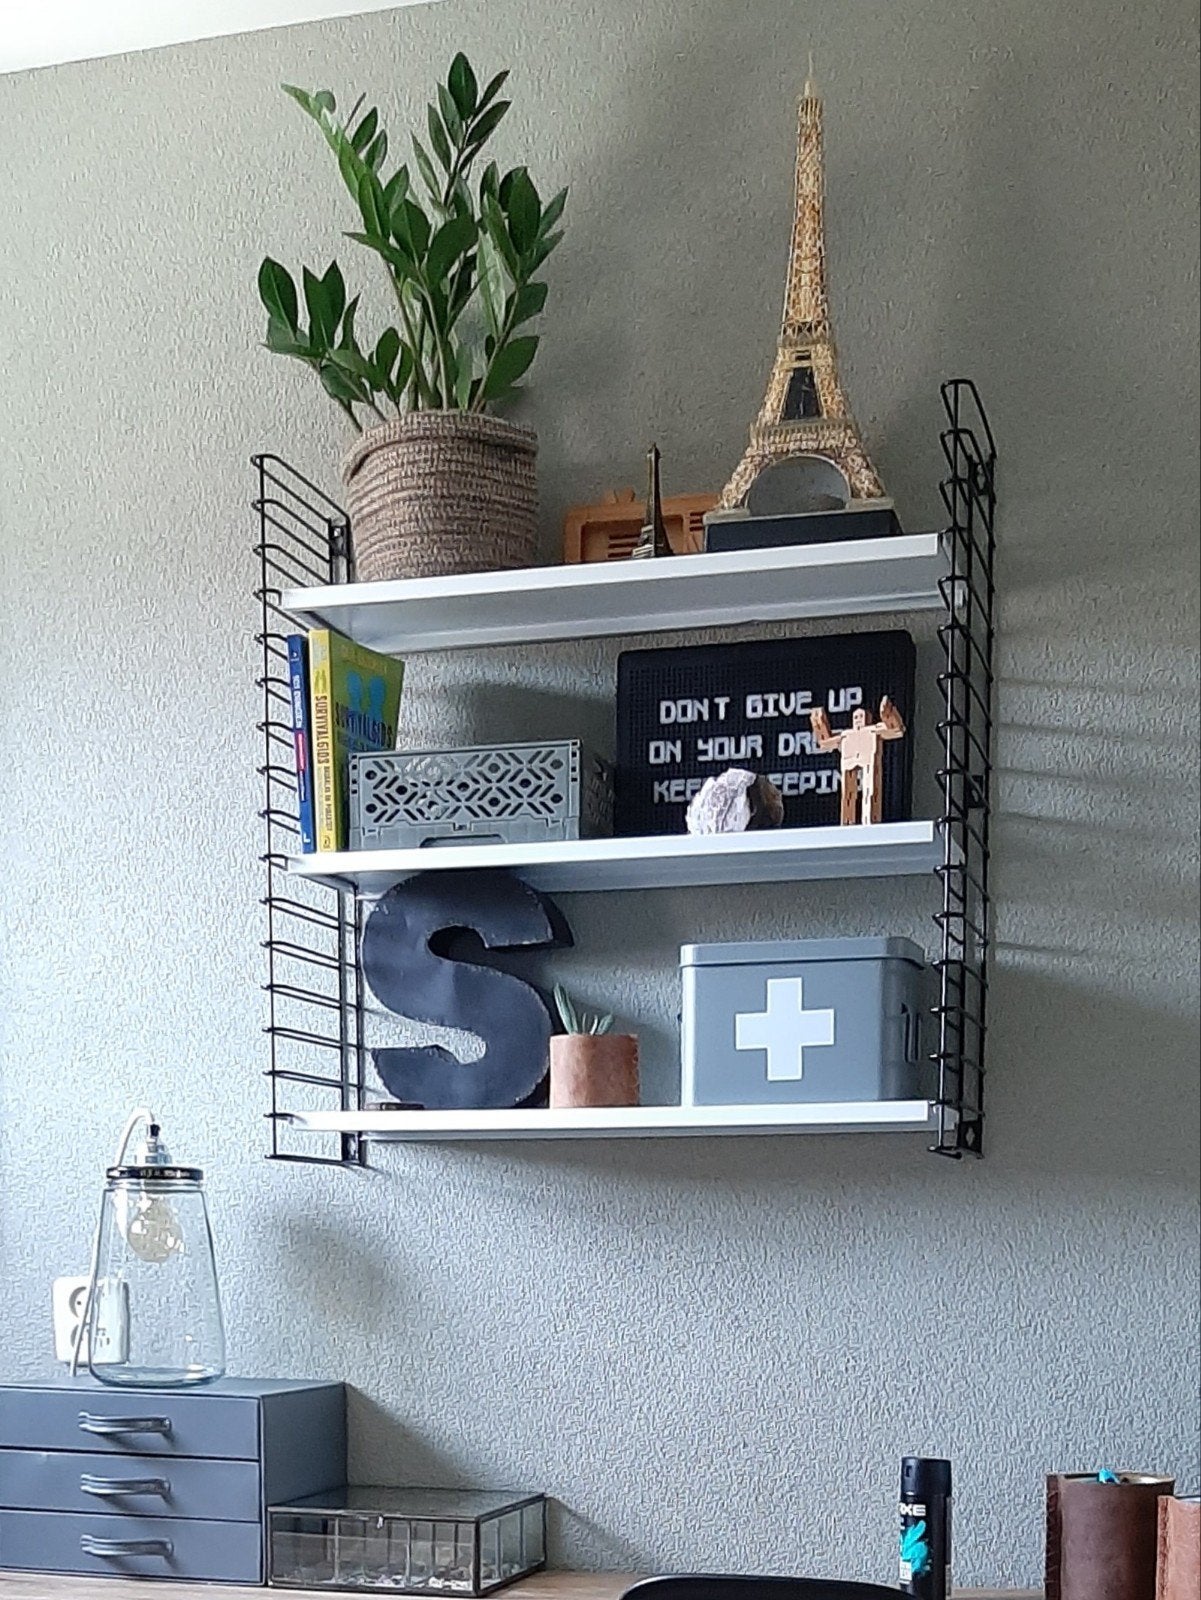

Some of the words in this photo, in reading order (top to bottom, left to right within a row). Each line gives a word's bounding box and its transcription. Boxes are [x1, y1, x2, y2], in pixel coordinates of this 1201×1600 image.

[746, 691, 812, 718] GIVE
[828, 686, 863, 713] UP
[649, 740, 682, 765] ON
[697, 735, 762, 761] YOUR
[652, 778, 708, 803] KEE
